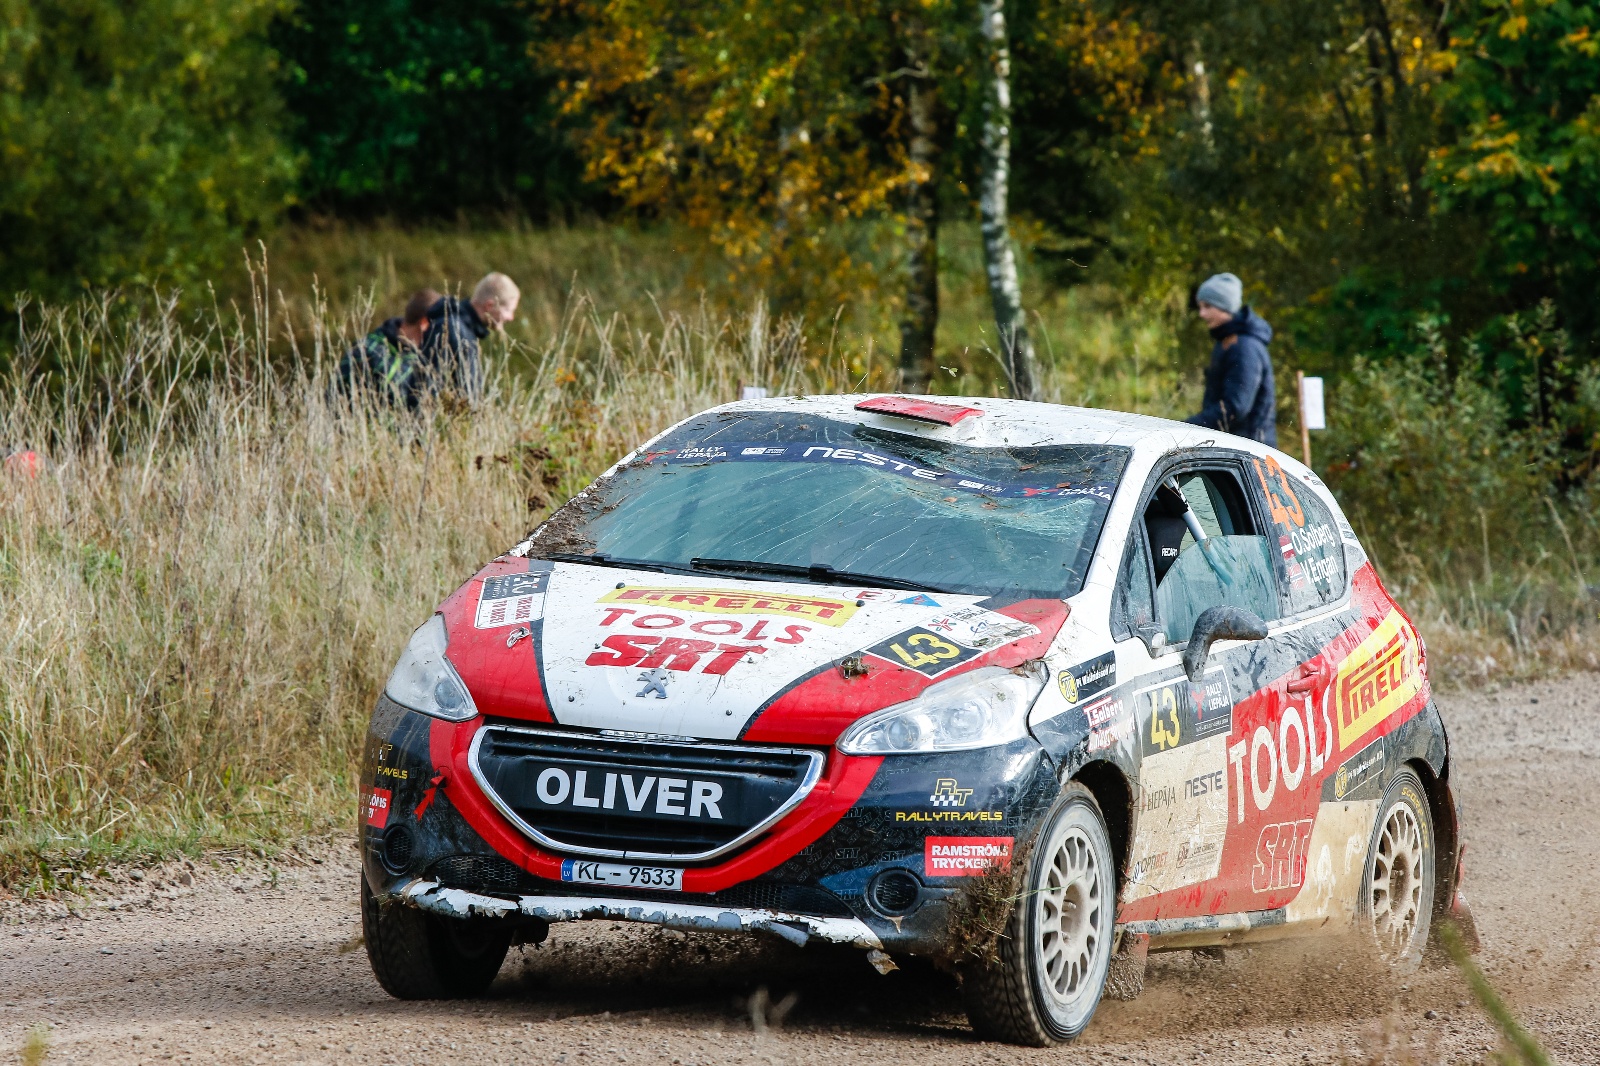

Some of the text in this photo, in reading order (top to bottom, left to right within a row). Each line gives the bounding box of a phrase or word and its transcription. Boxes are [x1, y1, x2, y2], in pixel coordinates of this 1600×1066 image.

[802, 446, 945, 480] NESTE
[1253, 455, 1304, 531] 43
[1291, 523, 1336, 555] O.Solberg
[1300, 556, 1339, 584] V.Engan
[617, 590, 845, 619] PIRELLI
[600, 607, 812, 645] TOOLS
[585, 634, 768, 675] SRT
[890, 633, 960, 667] 43
[1205, 681, 1222, 697] RALLY
[1083, 695, 1124, 728] T.Solberg
[1151, 687, 1180, 750] 43
[1229, 684, 1333, 825] TOOLS
[536, 767, 723, 819] OLIVER
[1184, 770, 1222, 800] NESTE
[895, 811, 1003, 821] RALLYTRAVELS
[1252, 818, 1313, 894] SRT
[578, 862, 606, 881] KL
[628, 866, 676, 886] 9533
